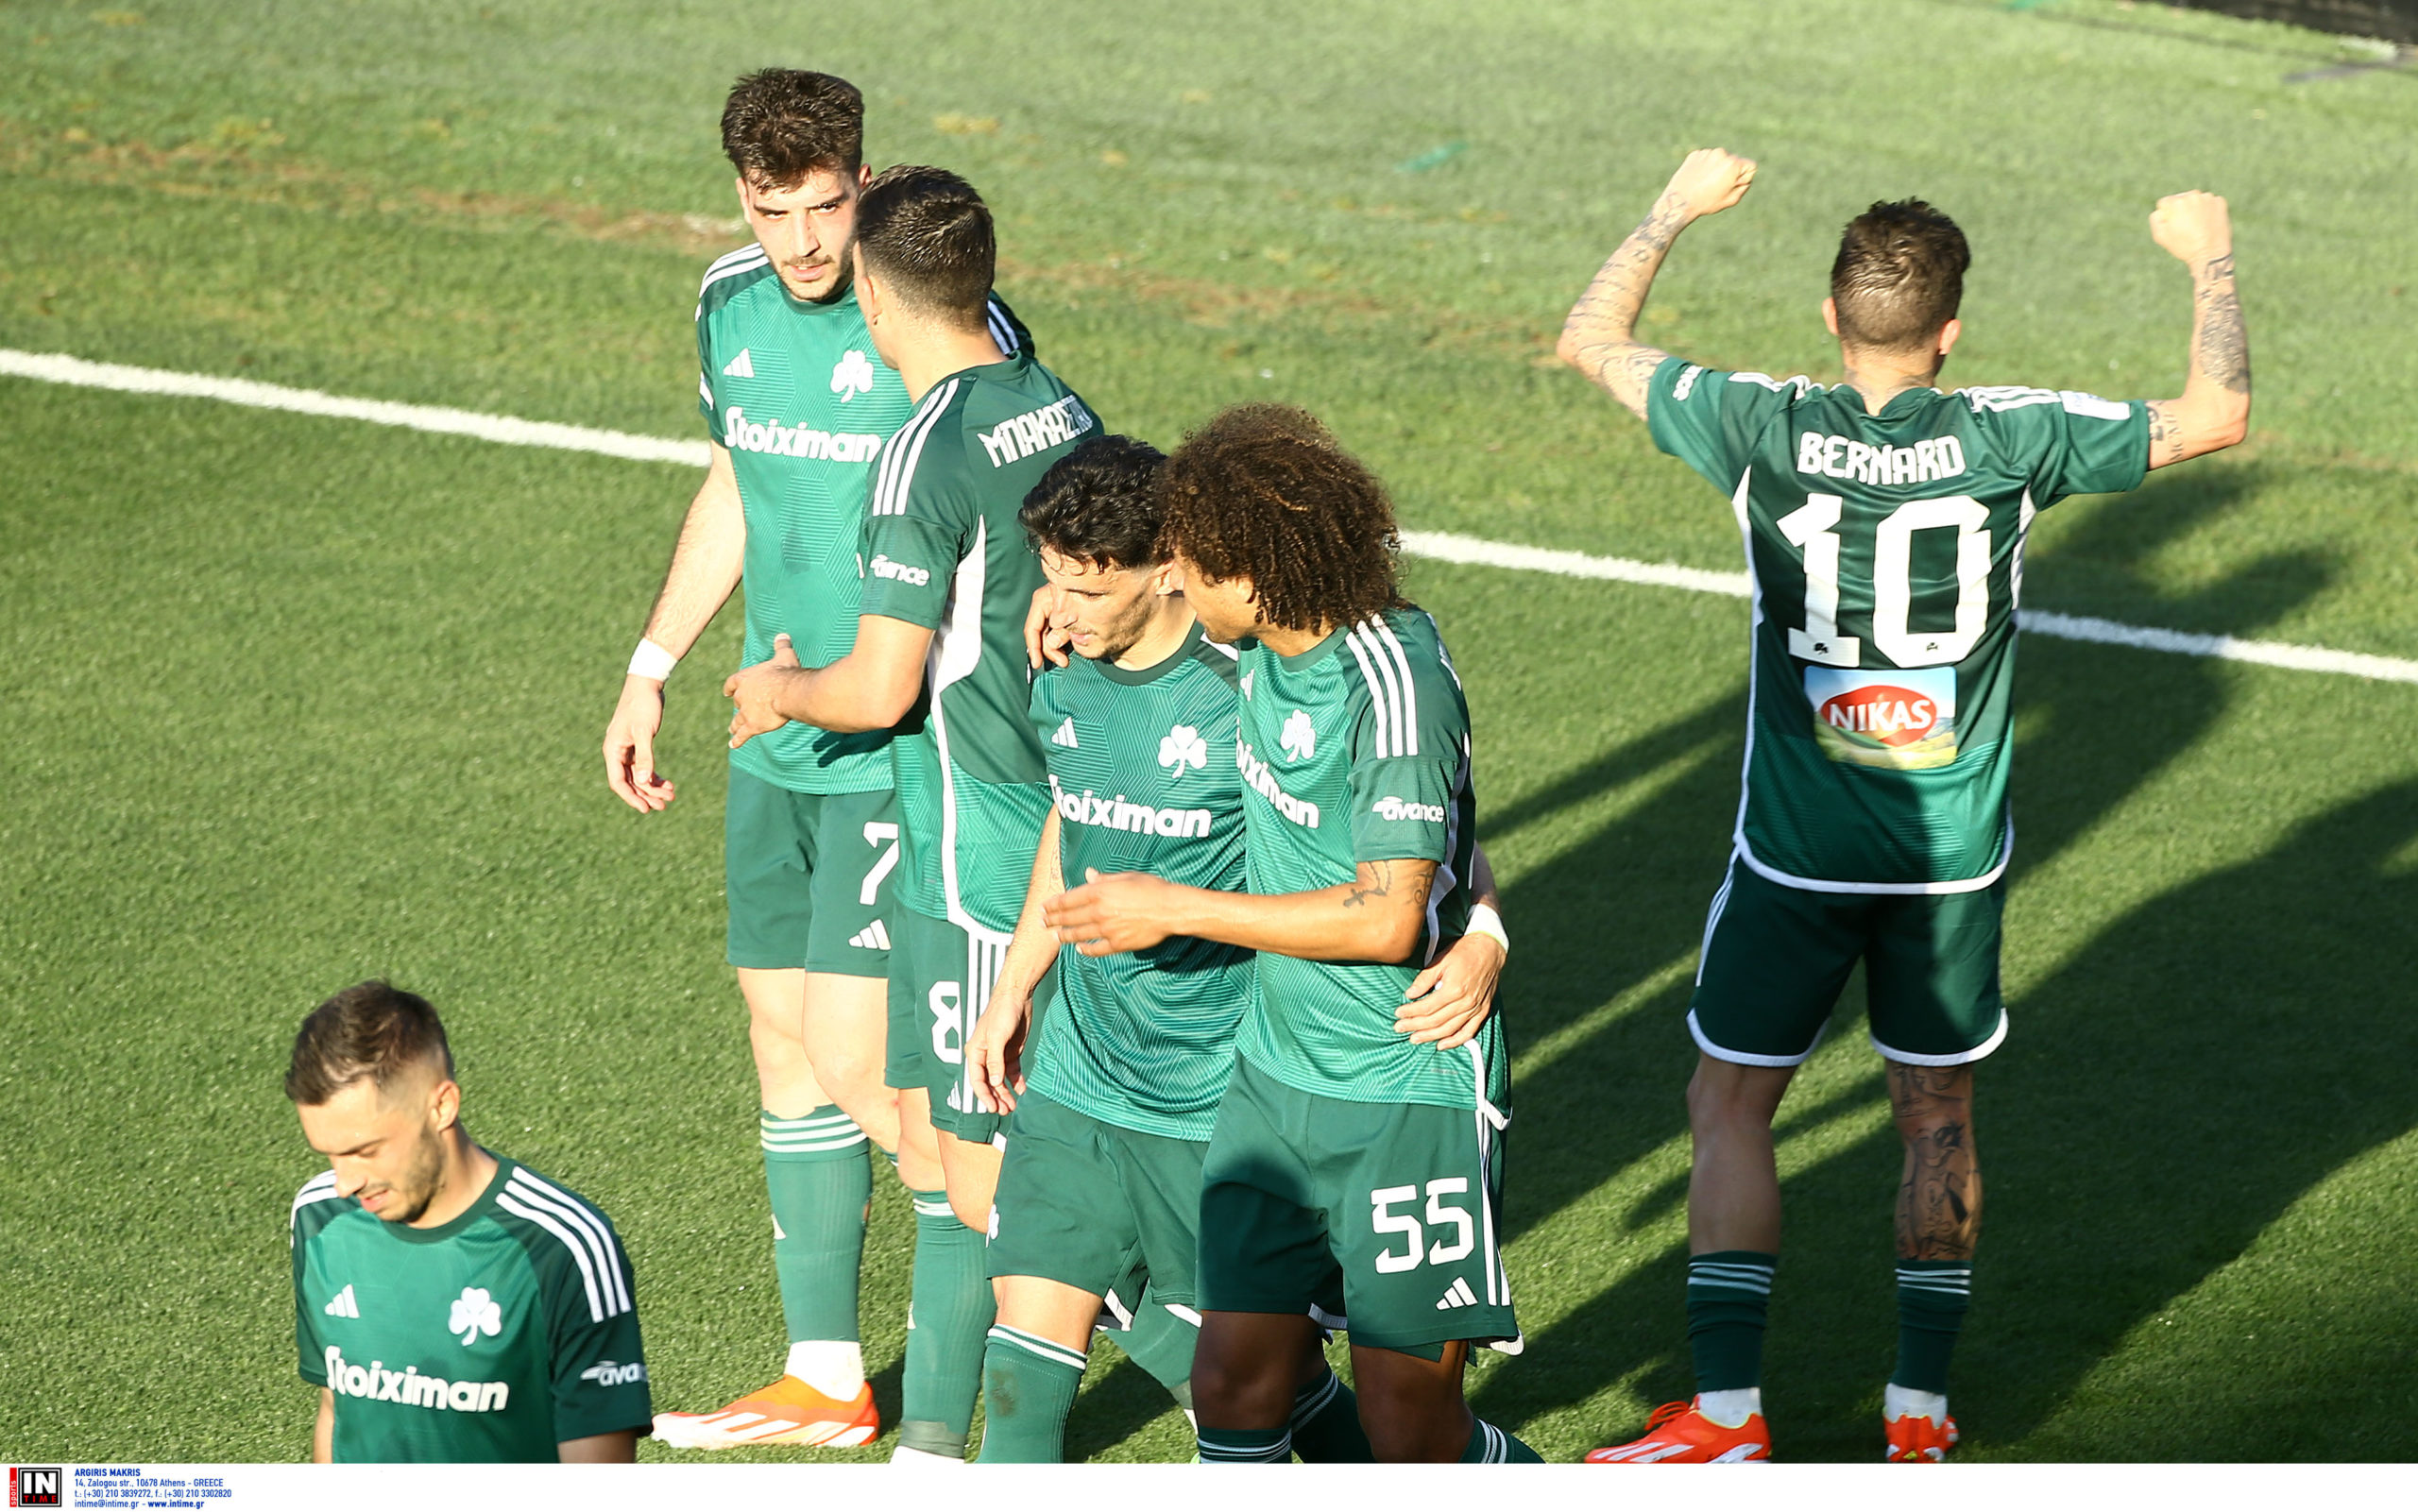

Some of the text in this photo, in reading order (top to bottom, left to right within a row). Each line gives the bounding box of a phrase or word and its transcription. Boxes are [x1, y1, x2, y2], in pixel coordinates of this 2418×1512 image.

[724, 406, 882, 463] Stoiximan
[1796, 432, 1967, 485] BERNARD
[1777, 492, 1993, 669] 10
[1830, 700, 1933, 732] NIKAS
[1235, 716, 1320, 829] oiximan
[1375, 797, 1445, 824] avance
[860, 821, 899, 906] 7
[928, 980, 962, 1064] 8
[1371, 1177, 1475, 1274] 55
[325, 1345, 510, 1413] Stoiximan
